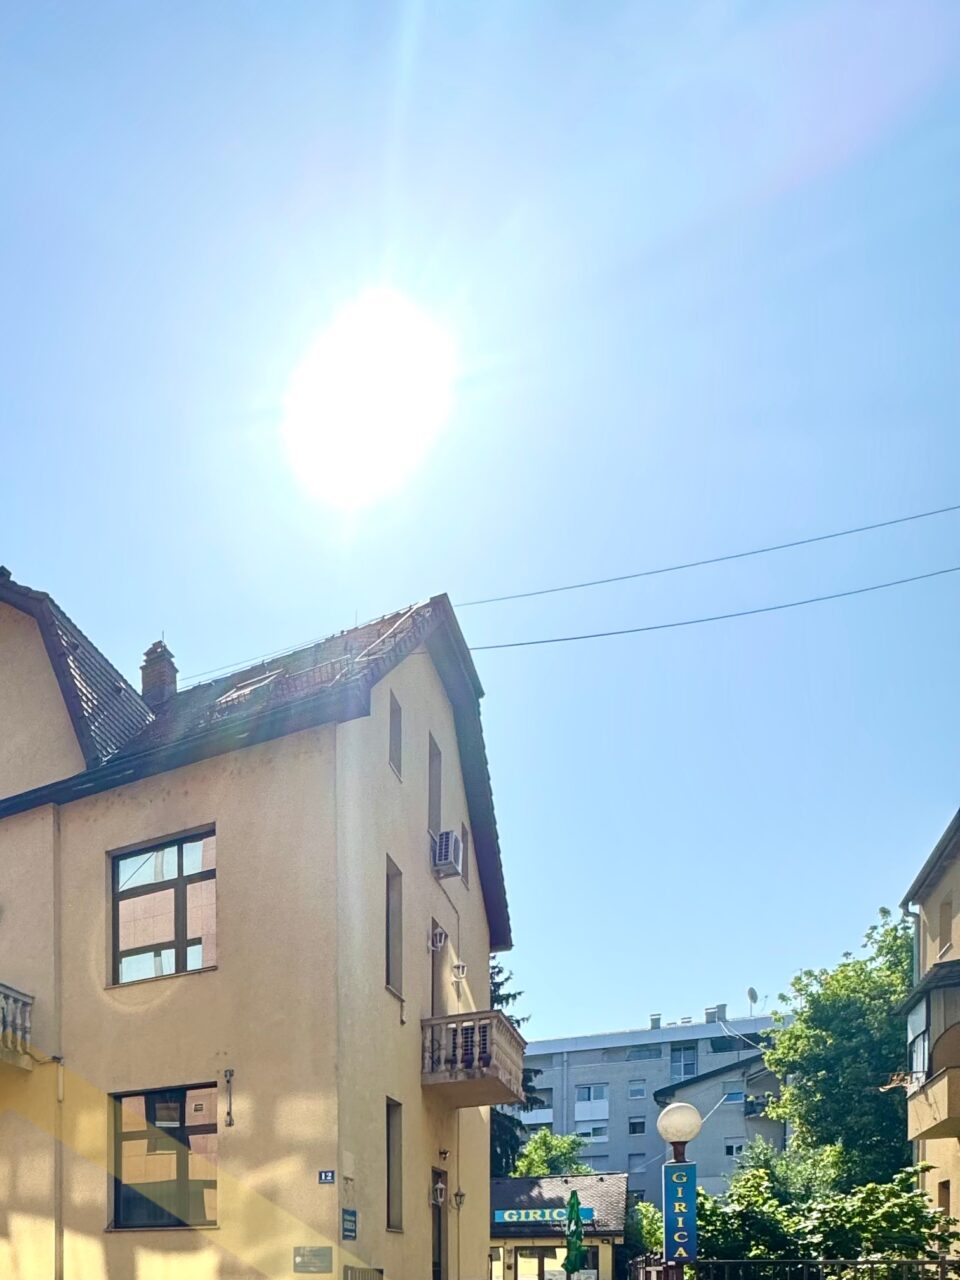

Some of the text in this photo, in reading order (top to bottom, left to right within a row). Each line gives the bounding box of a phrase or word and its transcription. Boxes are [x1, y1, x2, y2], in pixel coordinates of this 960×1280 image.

[321, 1172, 332, 1180] 12
[503, 1208, 582, 1222] GIRIC
[672, 1172, 688, 1257] GIRICA
